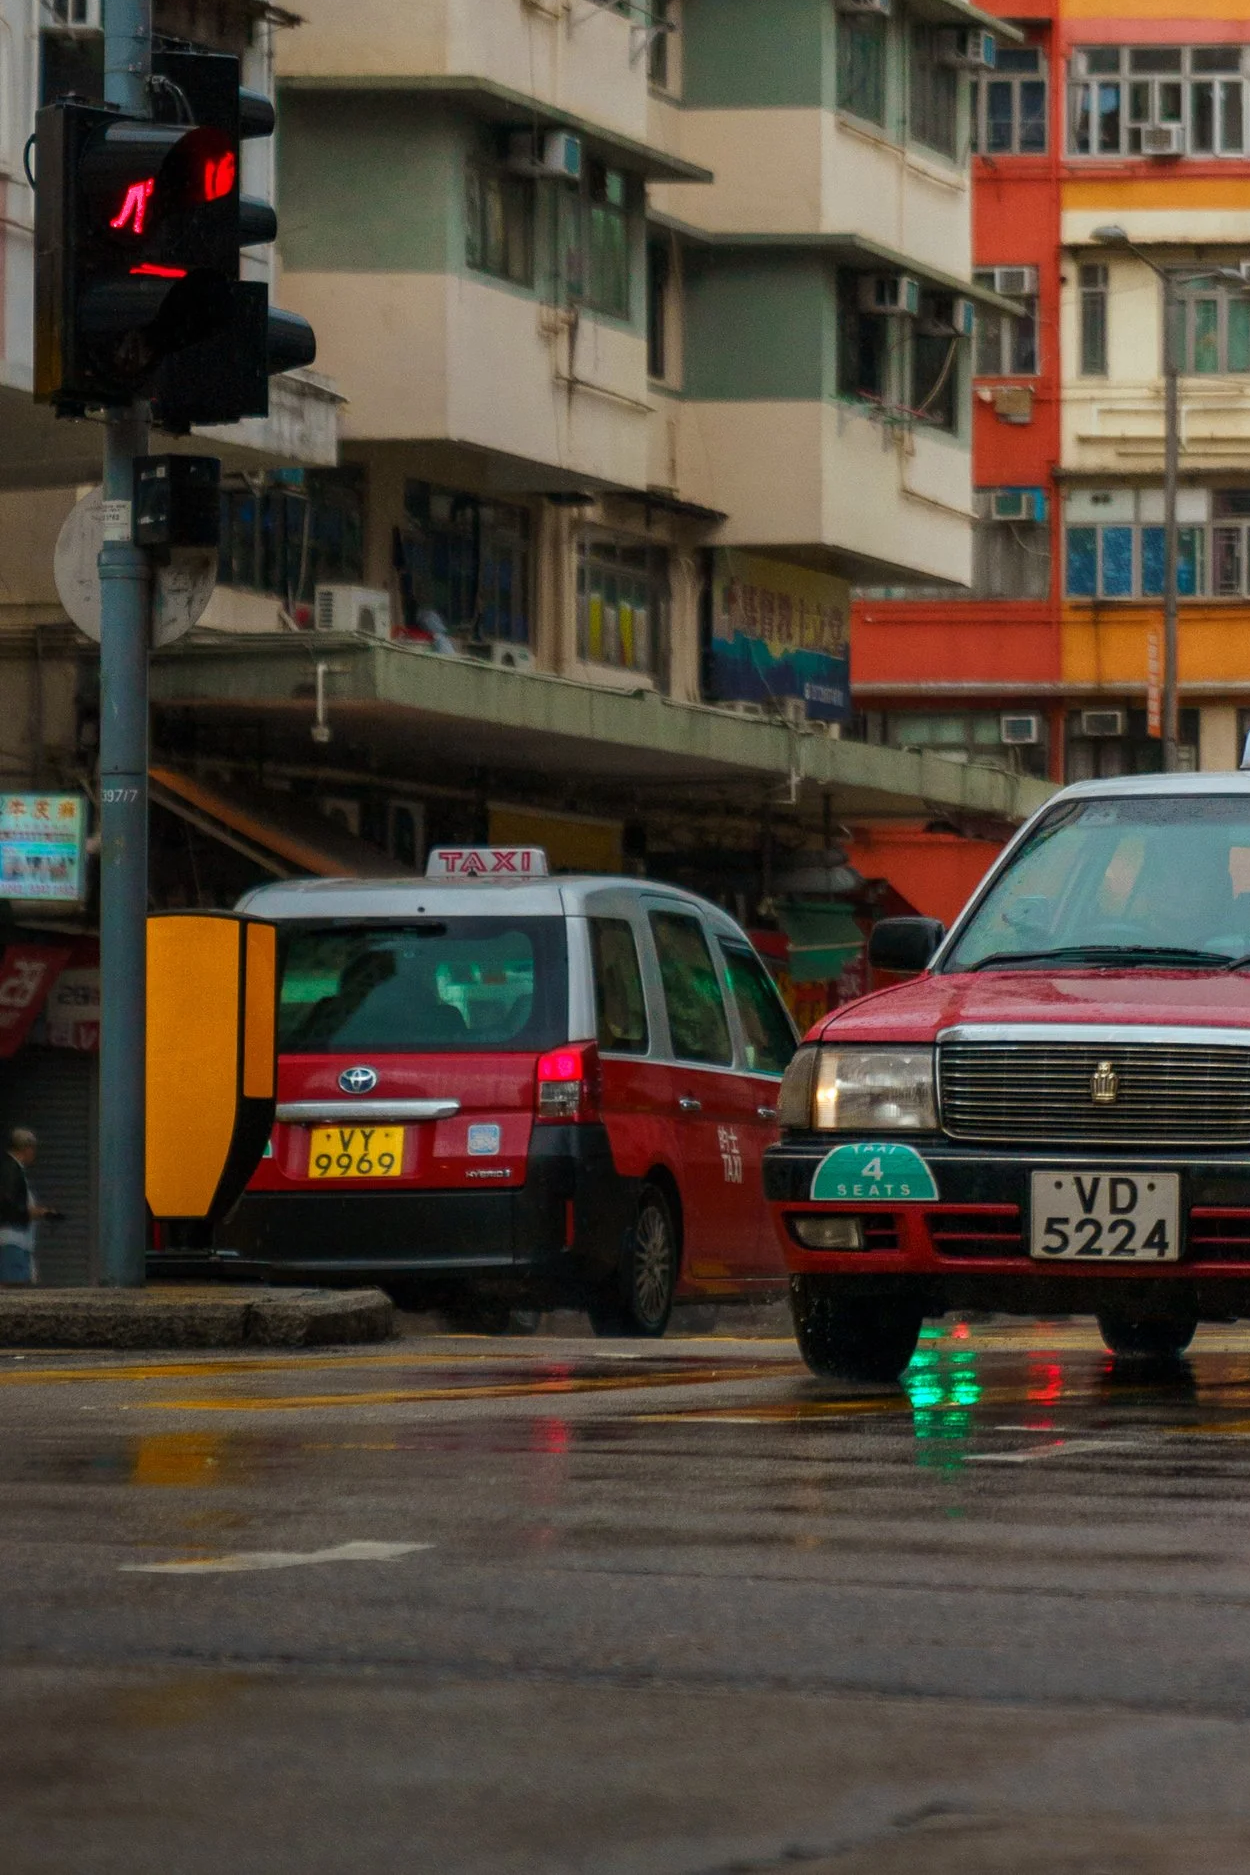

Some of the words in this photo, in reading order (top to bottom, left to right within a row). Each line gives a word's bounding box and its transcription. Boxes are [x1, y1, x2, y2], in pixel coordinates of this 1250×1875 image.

[438, 851, 531, 873] TAXI
[338, 1129, 376, 1153] VY
[314, 1152, 396, 1176] 9969
[721, 1152, 743, 1184] TAXI
[861, 1156, 884, 1181] 4
[837, 1183, 911, 1197] SEATS
[1073, 1176, 1139, 1216] VD
[1041, 1216, 1170, 1258] 5224
